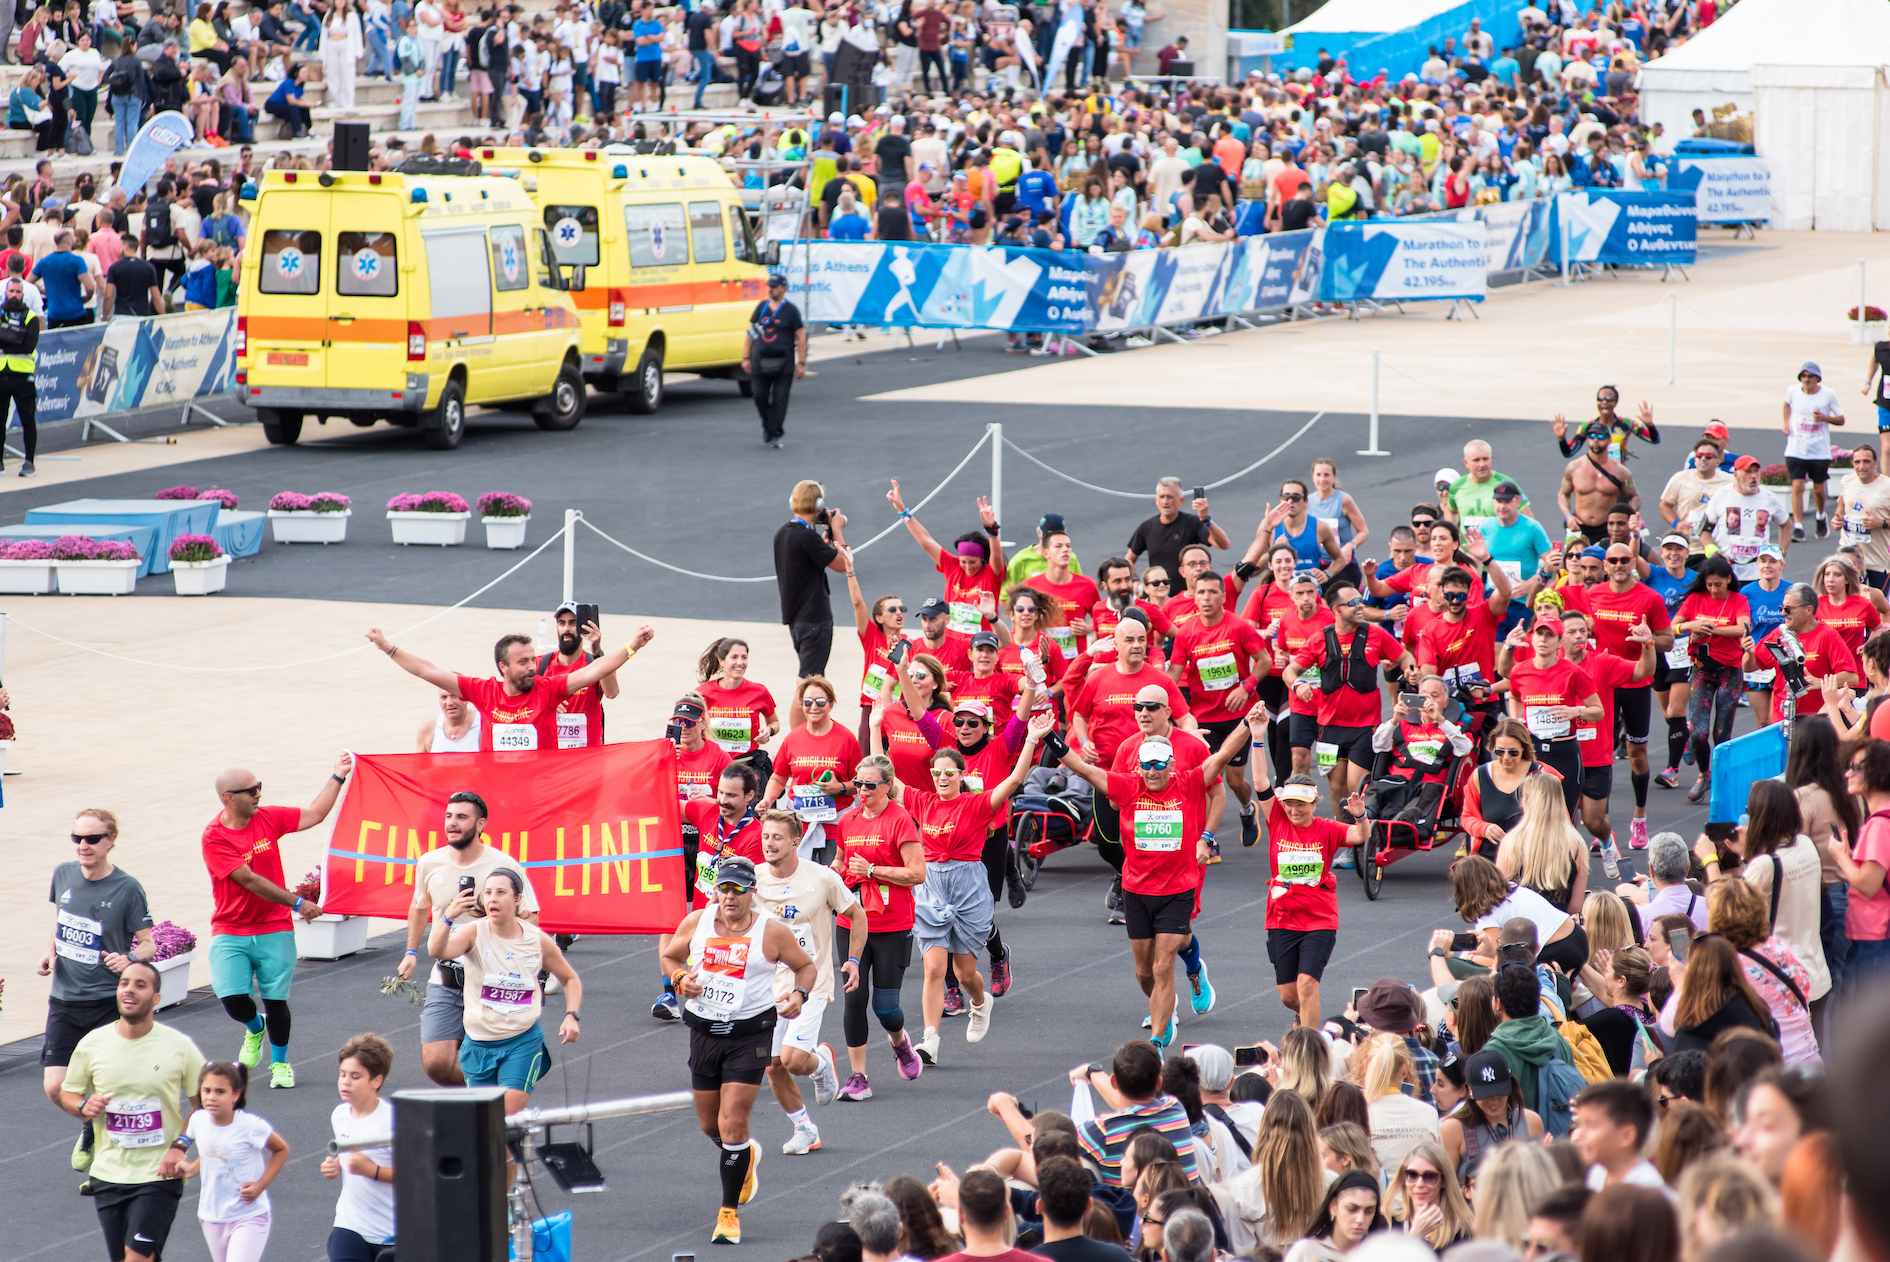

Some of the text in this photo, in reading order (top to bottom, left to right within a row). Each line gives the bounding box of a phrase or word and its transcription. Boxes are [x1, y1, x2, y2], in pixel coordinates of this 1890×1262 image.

[1708, 187, 1722, 198] The
[1403, 238, 1480, 250] Marathon to
[1403, 256, 1485, 268] The Authenti
[1206, 666, 1232, 678] 19614
[717, 730, 744, 739] 19623
[500, 737, 530, 747] 44349
[802, 796, 825, 808] 1713
[1145, 824, 1172, 835] 6760
[555, 816, 663, 896] LINE
[1286, 864, 1316, 876] 19604
[61, 926, 93, 946] 16003
[490, 988, 526, 1002] 21587
[703, 986, 735, 1005] 13172
[114, 1114, 153, 1129] 21739
